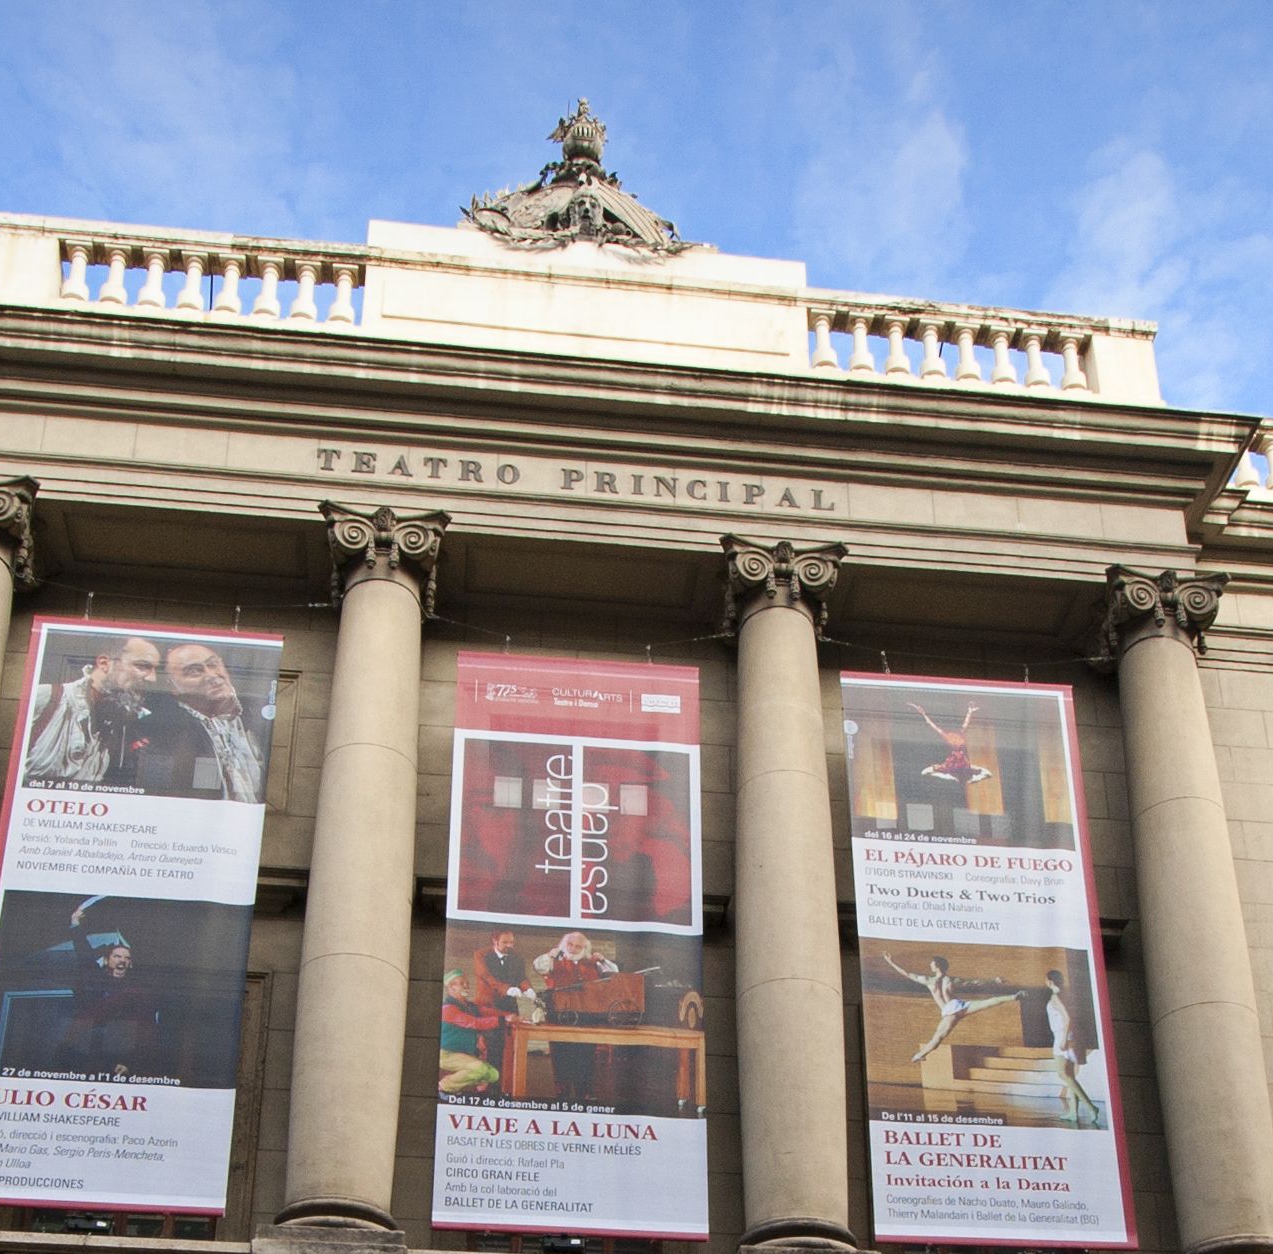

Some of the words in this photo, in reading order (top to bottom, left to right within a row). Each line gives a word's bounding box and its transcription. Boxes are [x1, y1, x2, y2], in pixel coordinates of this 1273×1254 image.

[317, 448, 519, 485] TEATRO
[561, 468, 835, 511] PRINCIPAL
[30, 780, 44, 788] del
[68, 782, 78, 790] 10
[81, 783, 93, 791] de
[95, 786, 145, 794] novembre
[27, 799, 108, 816] OTELO
[23, 818, 37, 827] DE
[38, 819, 83, 830] WILLIAM
[86, 822, 157, 834] SHAKESPEARE
[865, 849, 888, 862] EL
[894, 848, 967, 867] PÁJARO
[974, 855, 1001, 868] DE
[1007, 857, 1072, 872] FUEGO
[17, 861, 78, 872] NOVIEMBRE
[82, 865, 136, 876] COMPAÑÍA
[140, 868, 153, 877] DE
[157, 869, 194, 879] TEATRO
[866, 883, 900, 896] Two
[906, 887, 953, 899] Duets
[959, 889, 971, 900] &
[976, 890, 1010, 902] Two
[1014, 892, 1056, 904] Trios
[869, 915, 903, 925] BALLET
[907, 917, 919, 926] DE
[922, 918, 933, 926] LA
[937, 919, 999, 930] GENERALITAT
[2, 1068, 15, 1076] 27
[18, 1069, 31, 1077] de
[34, 1071, 86, 1080] novembre
[98, 1073, 110, 1081] l'1
[113, 1074, 126, 1082] de
[129, 1074, 180, 1085] desembre
[65, 1089, 147, 1111] CÉSAR
[449, 1095, 466, 1104] Del
[470, 1097, 479, 1105] 17
[483, 1098, 495, 1106] de
[498, 1099, 548, 1109] desembre
[551, 1102, 559, 1110] al
[562, 1103, 568, 1111] 5
[571, 1103, 583, 1112] de
[586, 1106, 615, 1114] gener
[43, 1113, 120, 1126] SHAKESPEARE
[882, 1112, 895, 1120] De
[928, 1114, 938, 1122] 15
[956, 1115, 1003, 1124] desembre
[448, 1114, 518, 1135] VIAJE
[525, 1119, 542, 1134] A
[551, 1121, 581, 1136] LA
[592, 1123, 657, 1141] LUNA
[447, 1136, 477, 1146] BASAT
[480, 1138, 493, 1147] EN
[496, 1139, 511, 1148] LES
[515, 1140, 544, 1150] OBRES
[548, 1141, 559, 1151] DE
[562, 1142, 596, 1153] VERNE
[599, 1144, 601, 1153] I
[884, 1130, 965, 1146] BALLET
[972, 1134, 1001, 1148] DE
[6, 1158, 31, 1168] Ulloa
[885, 1151, 912, 1165] LA
[919, 1152, 1067, 1170] GENERALITAT
[446, 1168, 478, 1178] CIRCO
[481, 1170, 512, 1180] GRAN
[516, 1171, 539, 1181] FELE
[886, 1174, 973, 1188] Invitación
[981, 1180, 989, 1189] a
[996, 1177, 1011, 1189] la
[1018, 1178, 1070, 1192] Danza
[445, 1183, 466, 1192] Amb
[470, 1184, 477, 1193] la
[543, 1188, 556, 1196] del
[445, 1197, 484, 1208] BALLET
[488, 1199, 502, 1208] DE
[505, 1200, 517, 1209] LA
[522, 1201, 593, 1212] GENERALITAT
[887, 1208, 918, 1220] Thierry
[921, 1210, 968, 1220] Malandain
[971, 1211, 974, 1220] i
[977, 1212, 1002, 1221] Ballet
[1005, 1213, 1015, 1221] de
[1018, 1213, 1026, 1222] la
[1029, 1214, 1078, 1223] Generalitat
[1080, 1216, 1099, 1224] (BG)
